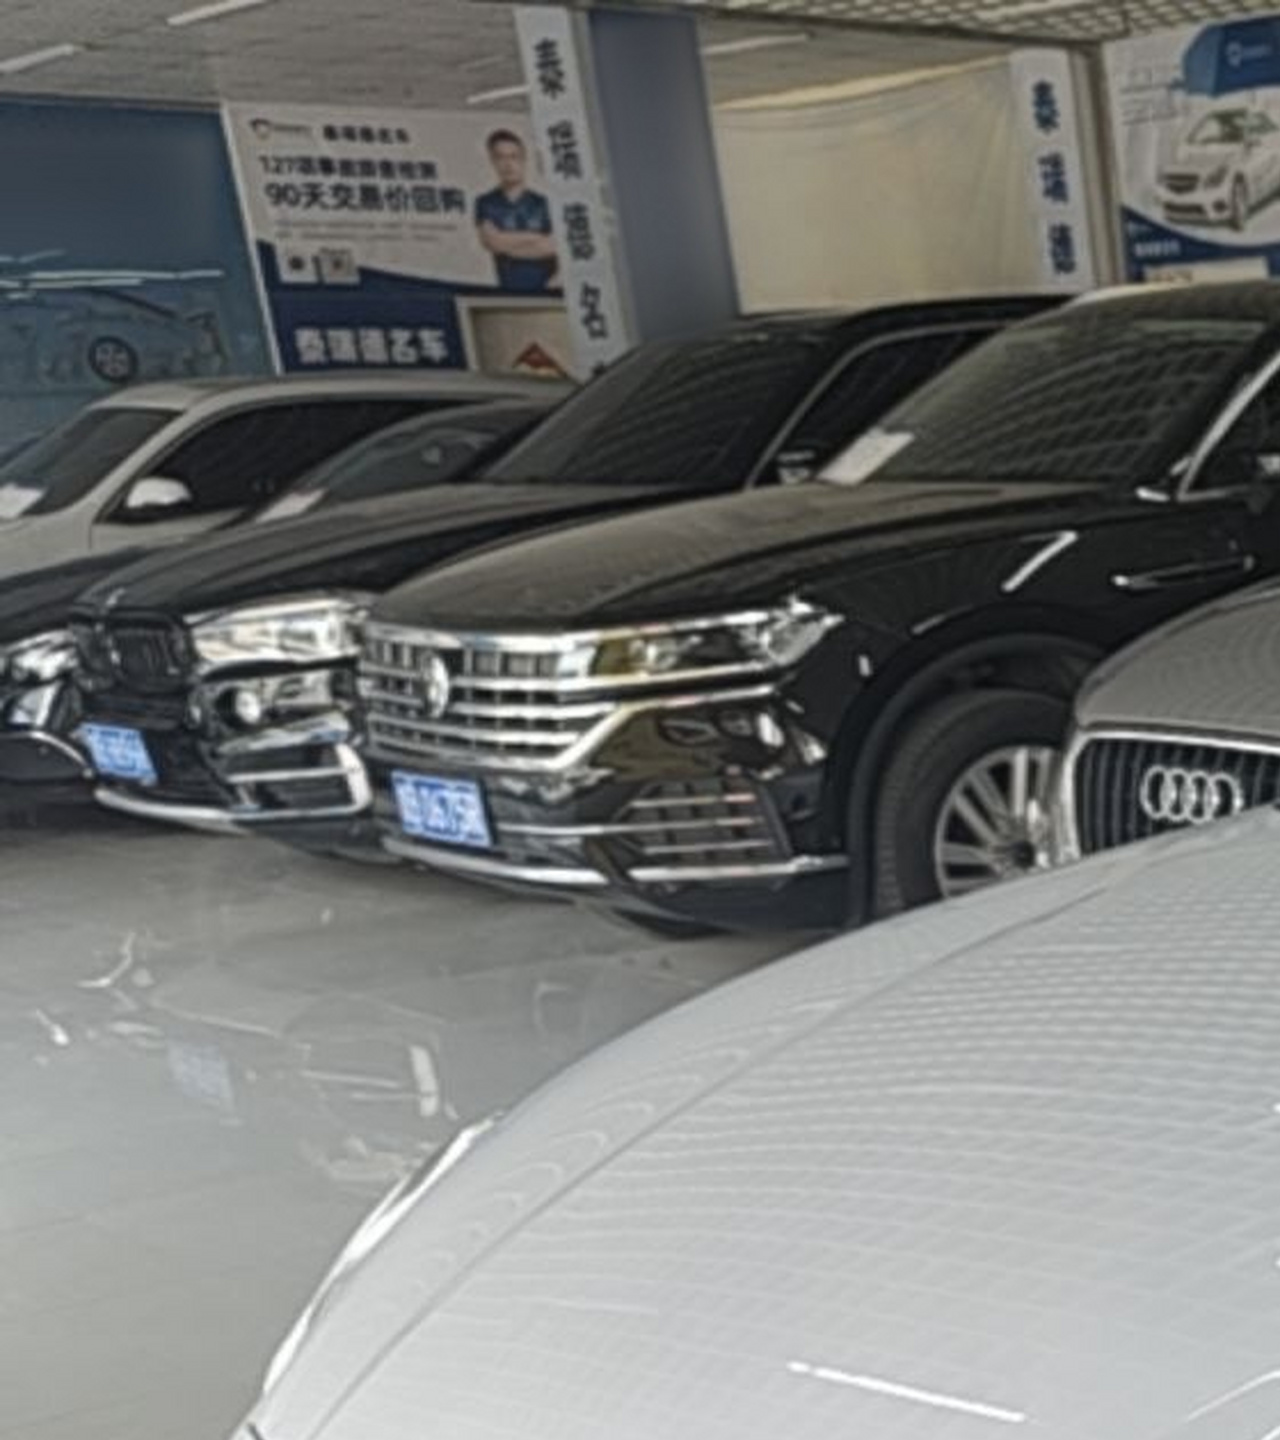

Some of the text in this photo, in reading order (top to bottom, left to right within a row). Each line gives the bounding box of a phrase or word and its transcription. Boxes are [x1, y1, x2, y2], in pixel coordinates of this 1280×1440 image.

[264, 181, 466, 213] 90天交易价回购
